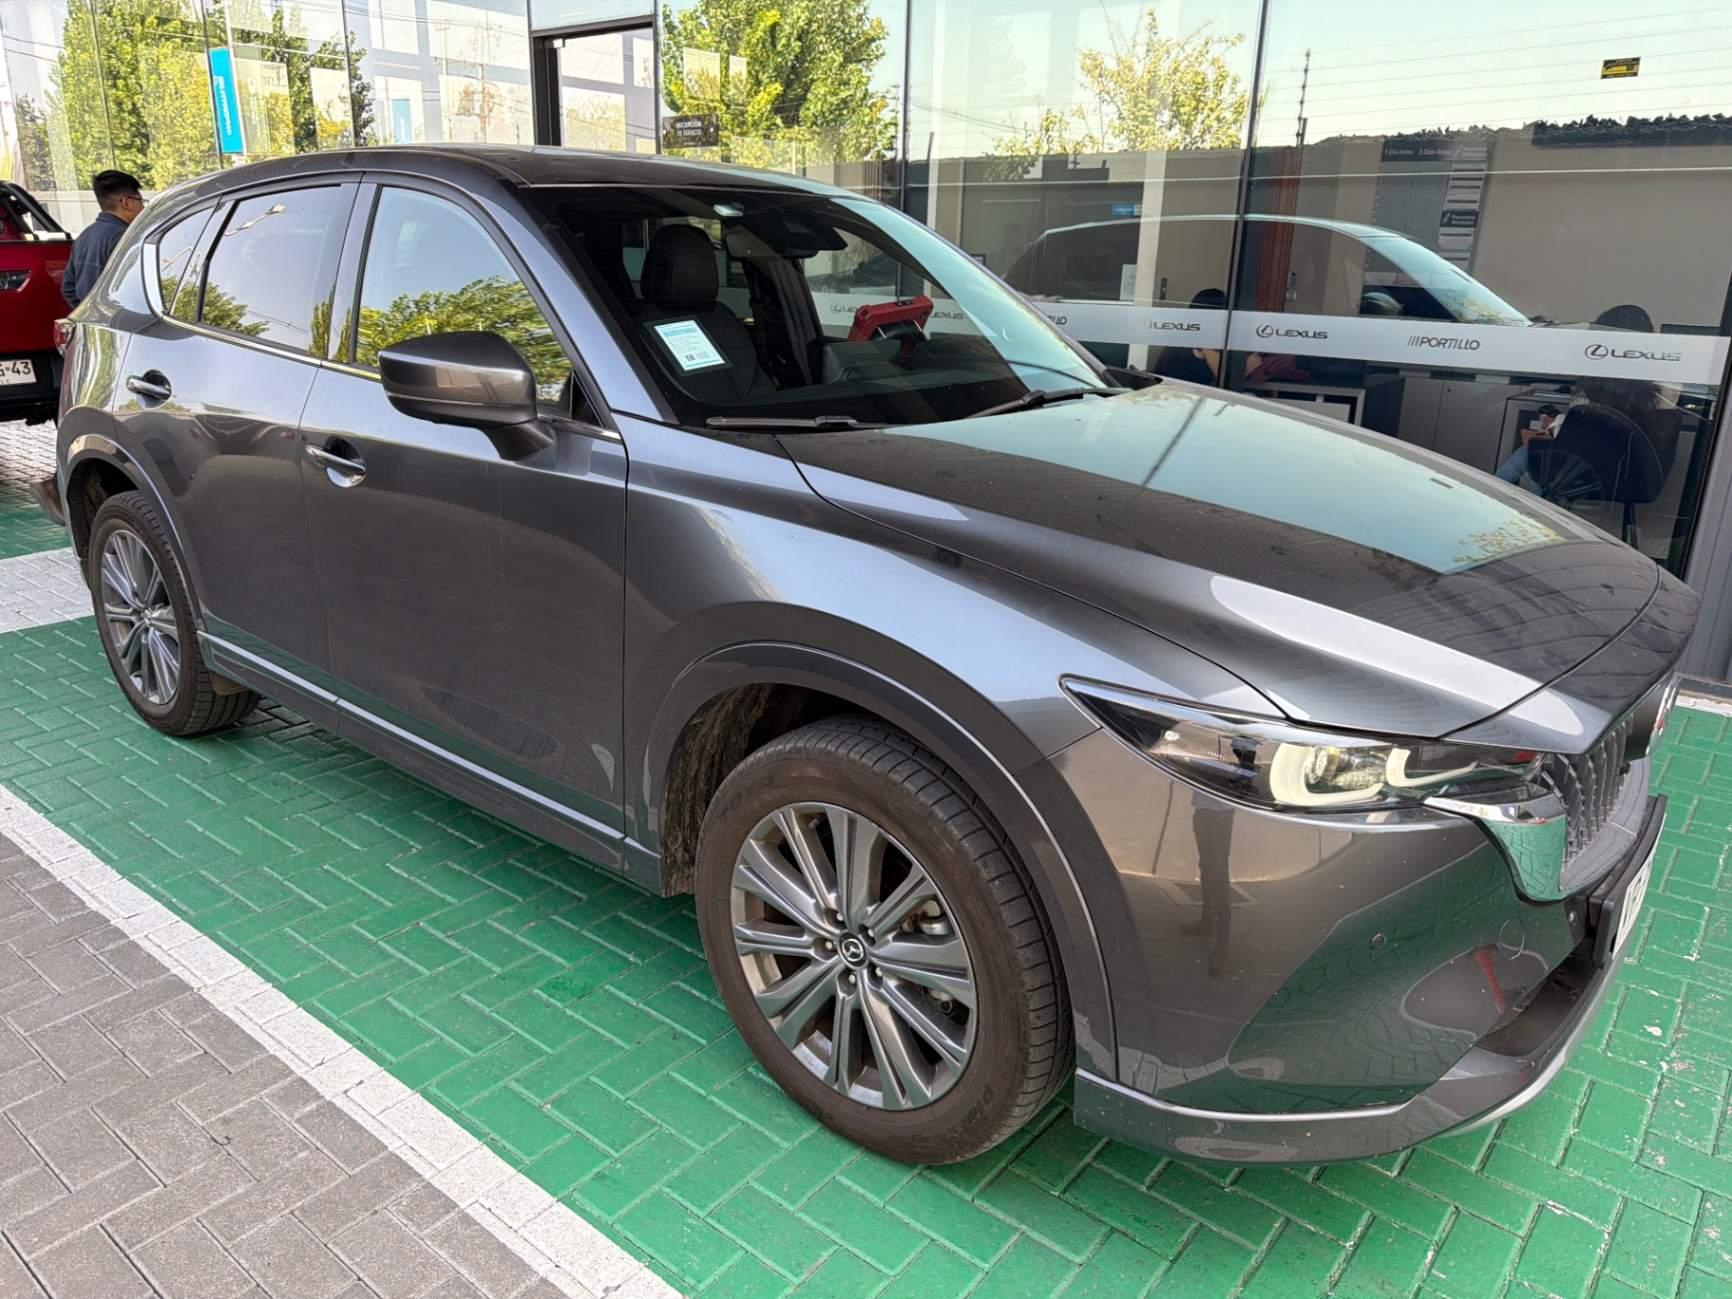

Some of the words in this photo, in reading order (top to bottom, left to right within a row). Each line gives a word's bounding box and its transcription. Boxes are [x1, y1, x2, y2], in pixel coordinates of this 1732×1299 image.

[1153, 321, 1201, 331] LEXUS
[1275, 328, 1328, 339] LEXUS
[1611, 348, 1681, 361] LEXUS
